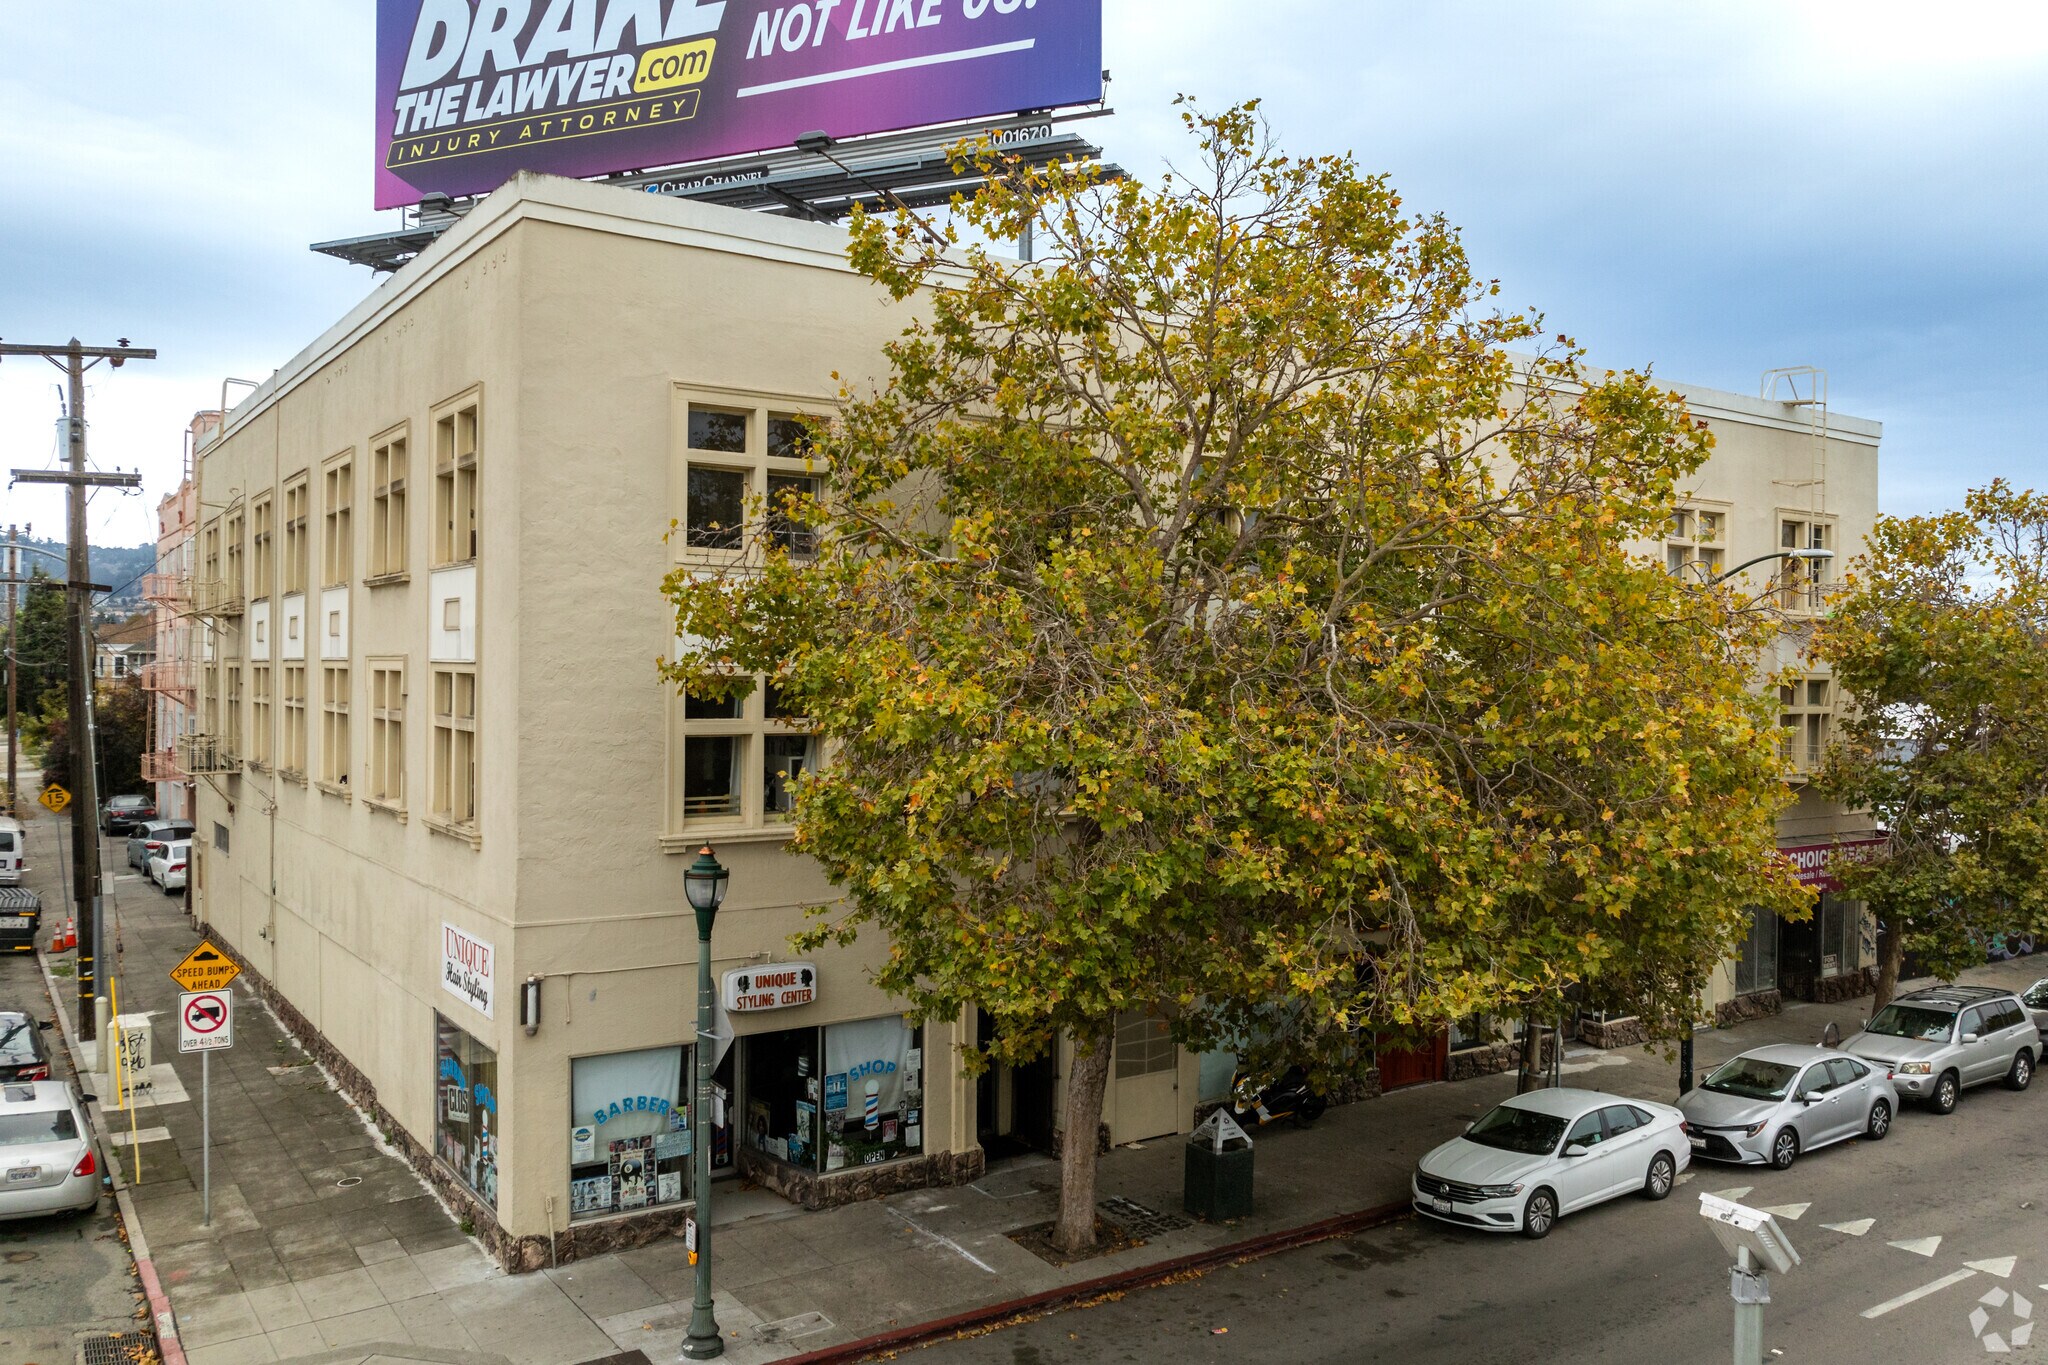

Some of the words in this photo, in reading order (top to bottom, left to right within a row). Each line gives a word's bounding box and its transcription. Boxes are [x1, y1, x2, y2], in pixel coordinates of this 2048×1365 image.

[746, 0, 841, 59] NOT
[846, 0, 942, 41] LIKE
[394, 84, 464, 136] THE
[463, 54, 636, 123] LAWYER
[640, 49, 708, 84] .com
[398, 130, 500, 160] INJURY
[519, 99, 687, 140] ATTORNEY
[47, 793, 65, 804] 15
[445, 926, 489, 978] UNIQUE
[177, 967, 204, 978] SPEED
[207, 965, 235, 976] BUMPS
[755, 972, 797, 989] UNIQUE
[191, 979, 221, 990] AHEAD
[446, 961, 462, 988] Hair
[463, 971, 488, 1011] Styling
[736, 993, 775, 1010] STYLING
[781, 989, 812, 1005] CENTER
[183, 1039, 198, 1048] OVER
[214, 1035, 229, 1045] TONS
[848, 1060, 897, 1081] SHOP
[449, 1088, 468, 1114] CLOS
[594, 1095, 670, 1126] BARBER
[865, 1150, 886, 1163] OPEN
